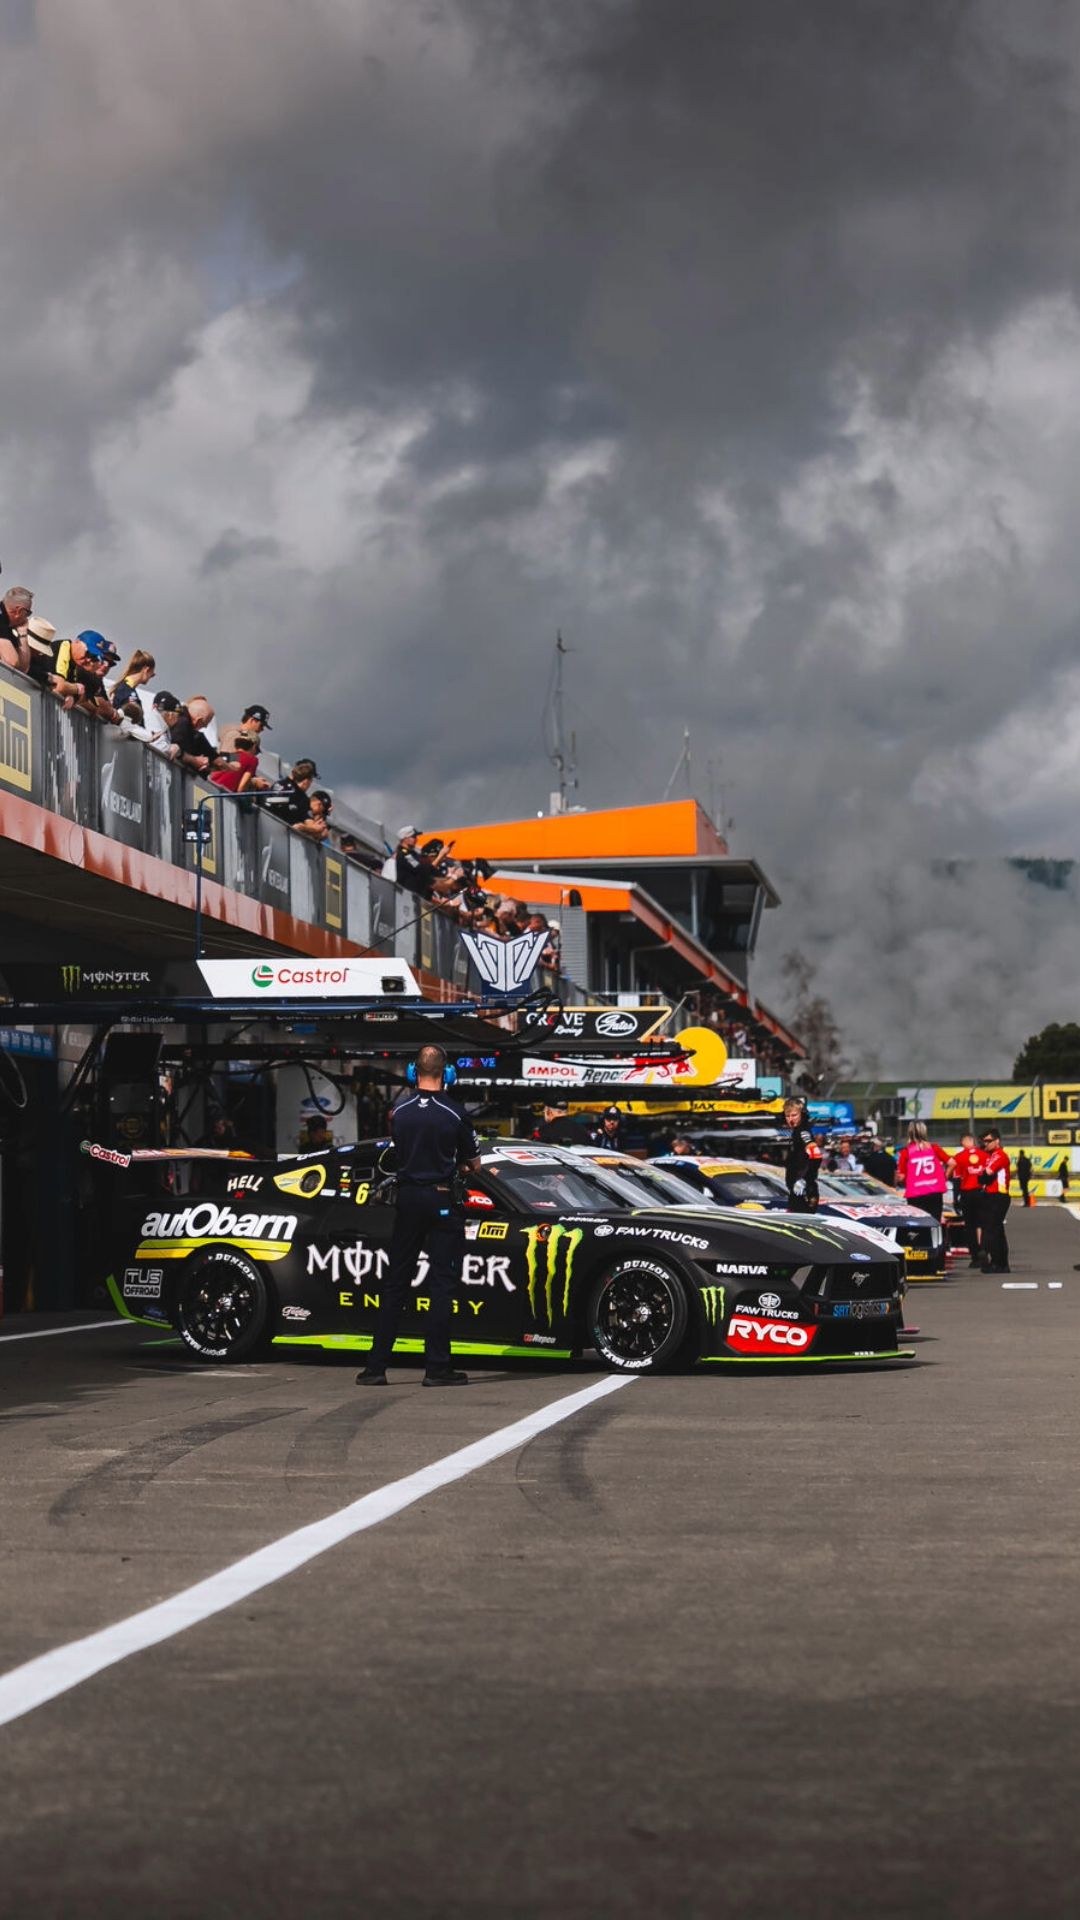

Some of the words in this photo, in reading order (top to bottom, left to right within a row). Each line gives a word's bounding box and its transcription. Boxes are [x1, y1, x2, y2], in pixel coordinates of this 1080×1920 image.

[83, 971, 150, 983] MONSTER
[278, 969, 348, 983] Castrol
[527, 1066, 577, 1076] AMPOL
[92, 1145, 130, 1166] Castrol
[911, 1157, 935, 1177] 75
[227, 1175, 263, 1192] HELL
[355, 1183, 369, 1204] 6
[616, 1227, 653, 1237] FAW
[653, 1229, 709, 1250] TRUCKS
[215, 1253, 255, 1280] DUNLOP
[623, 1260, 670, 1280] DUNLOP
[716, 1264, 767, 1275] NARVA
[127, 1272, 161, 1283] TUS
[125, 1286, 160, 1296] OFFROAD
[735, 1304, 761, 1314] FAW
[761, 1308, 800, 1320] TRUCKS
[727, 1318, 808, 1346] RYCO
